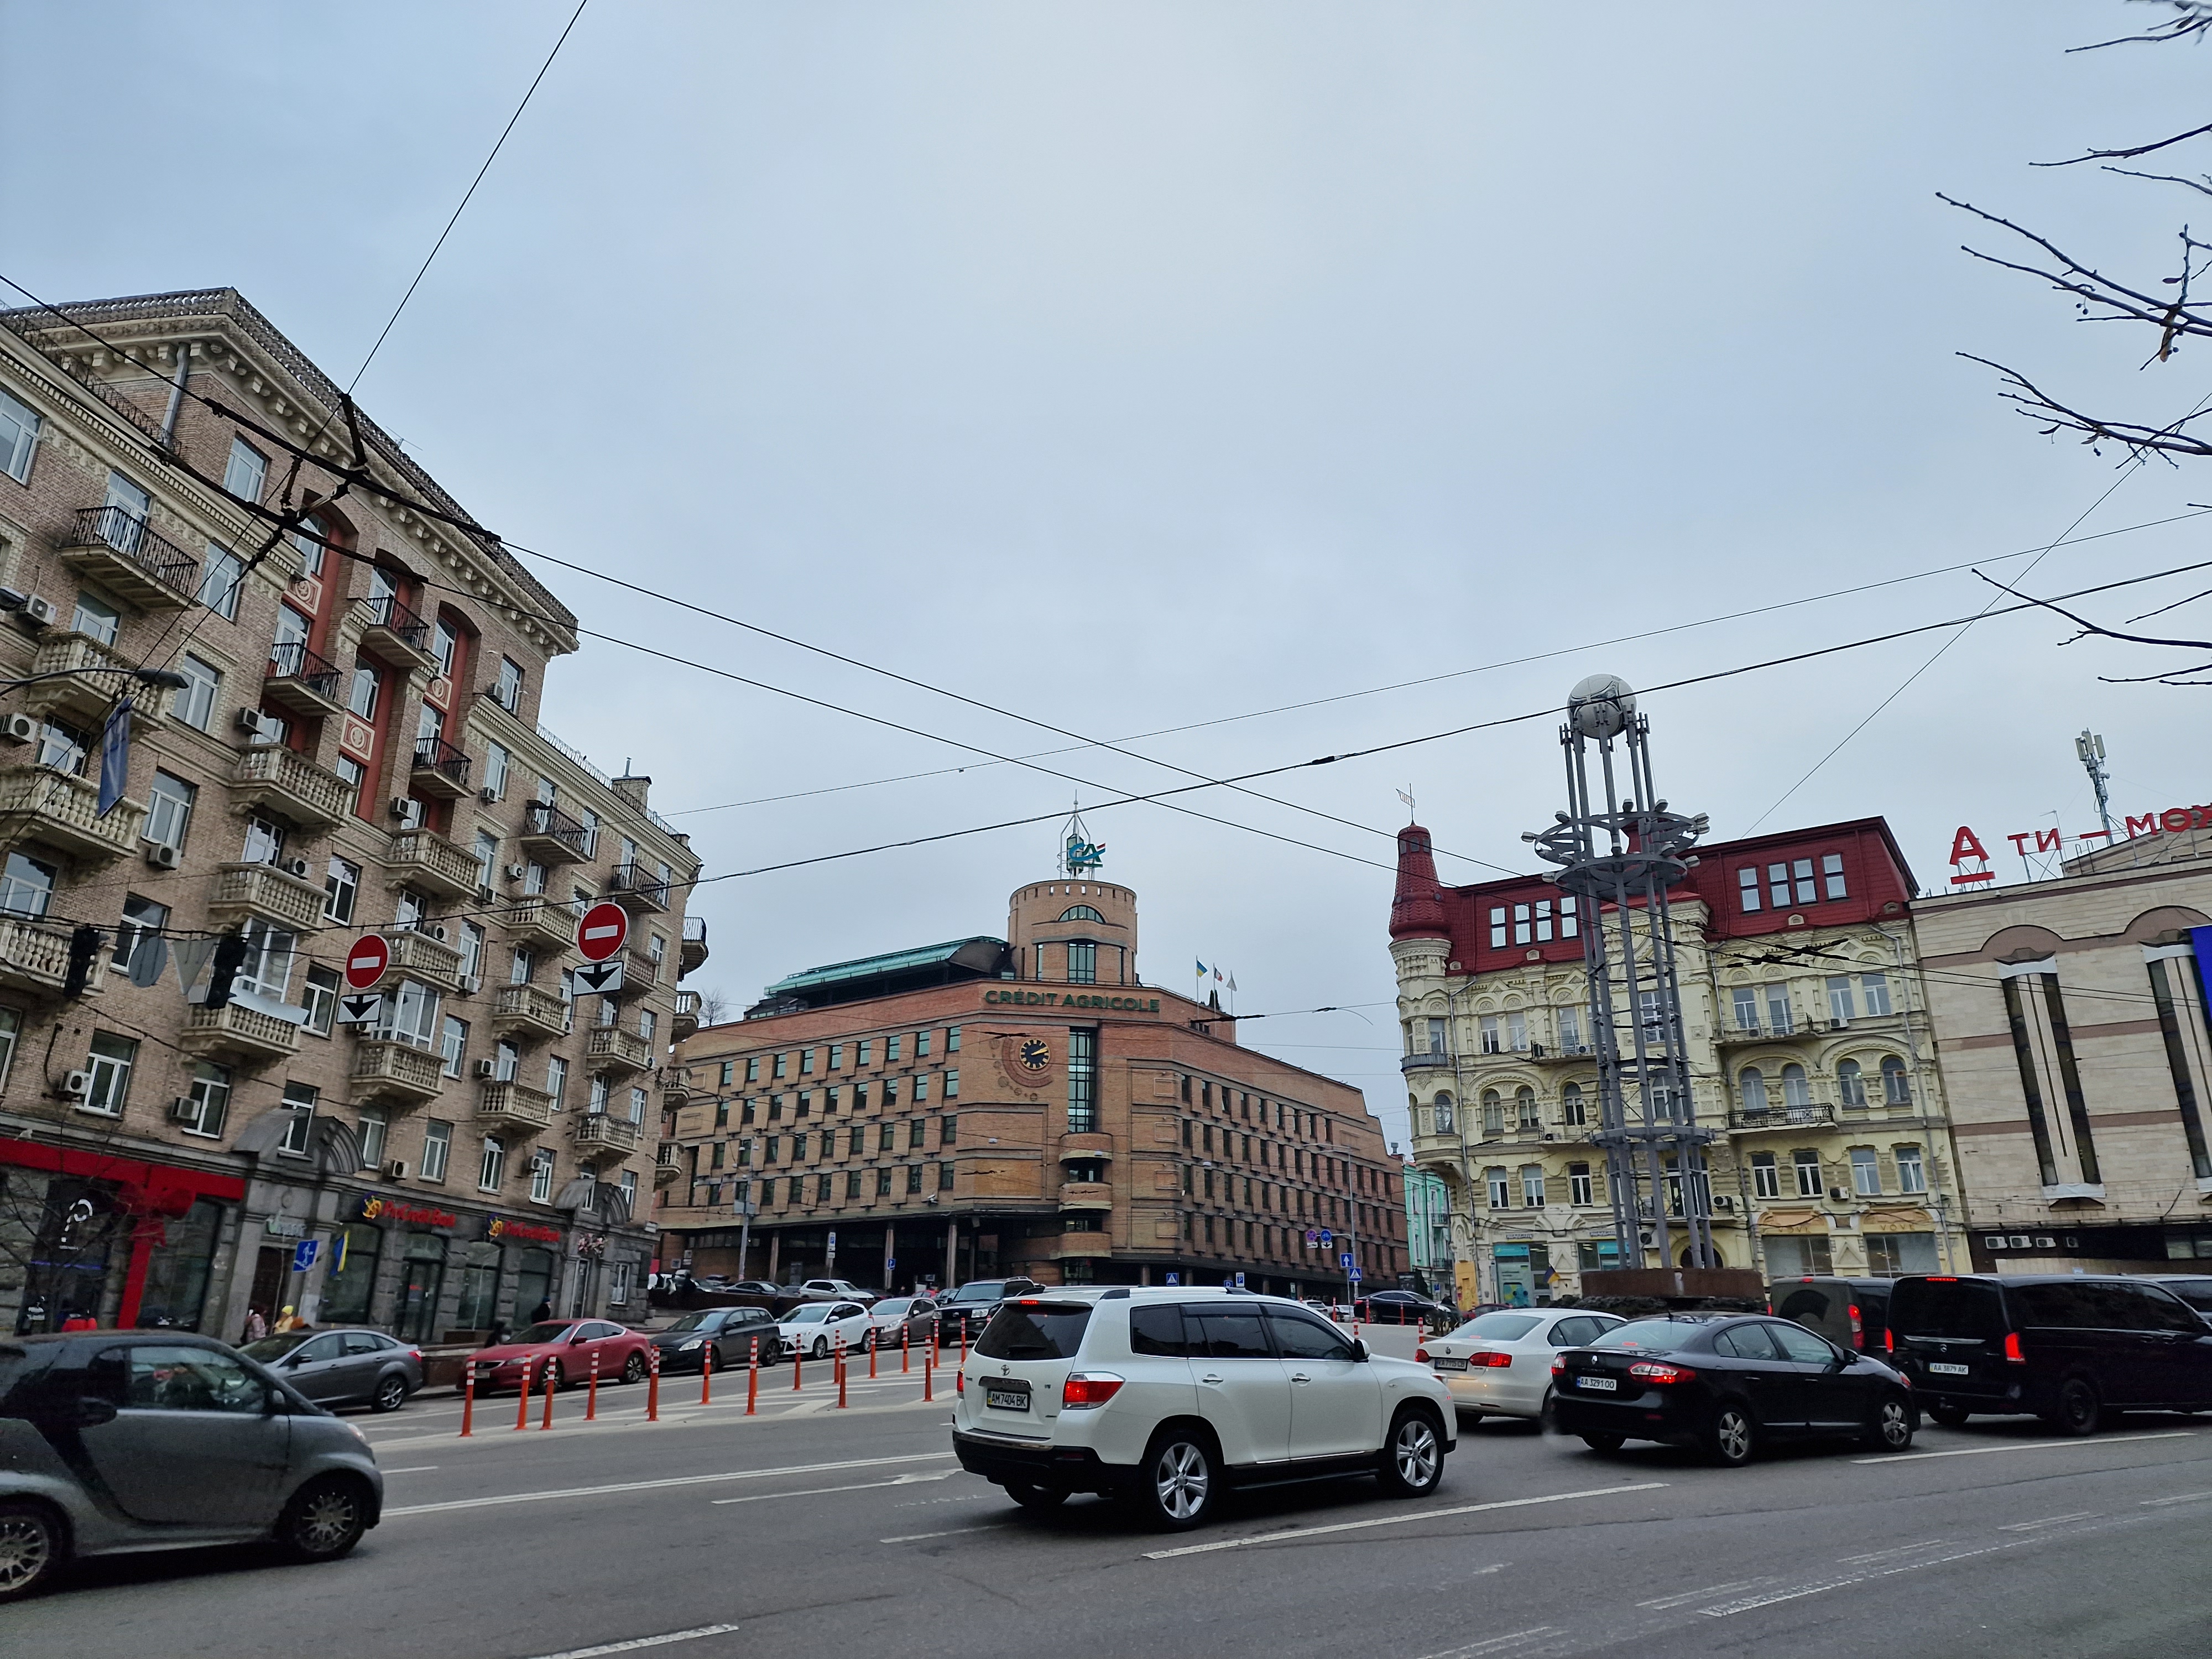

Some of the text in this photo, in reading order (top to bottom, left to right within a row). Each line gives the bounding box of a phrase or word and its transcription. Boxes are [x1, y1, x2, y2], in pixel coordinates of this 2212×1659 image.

[985, 988, 1160, 1012] CRÉDIT AGRICOLE
[1001, 1394, 1015, 1406] 7404
